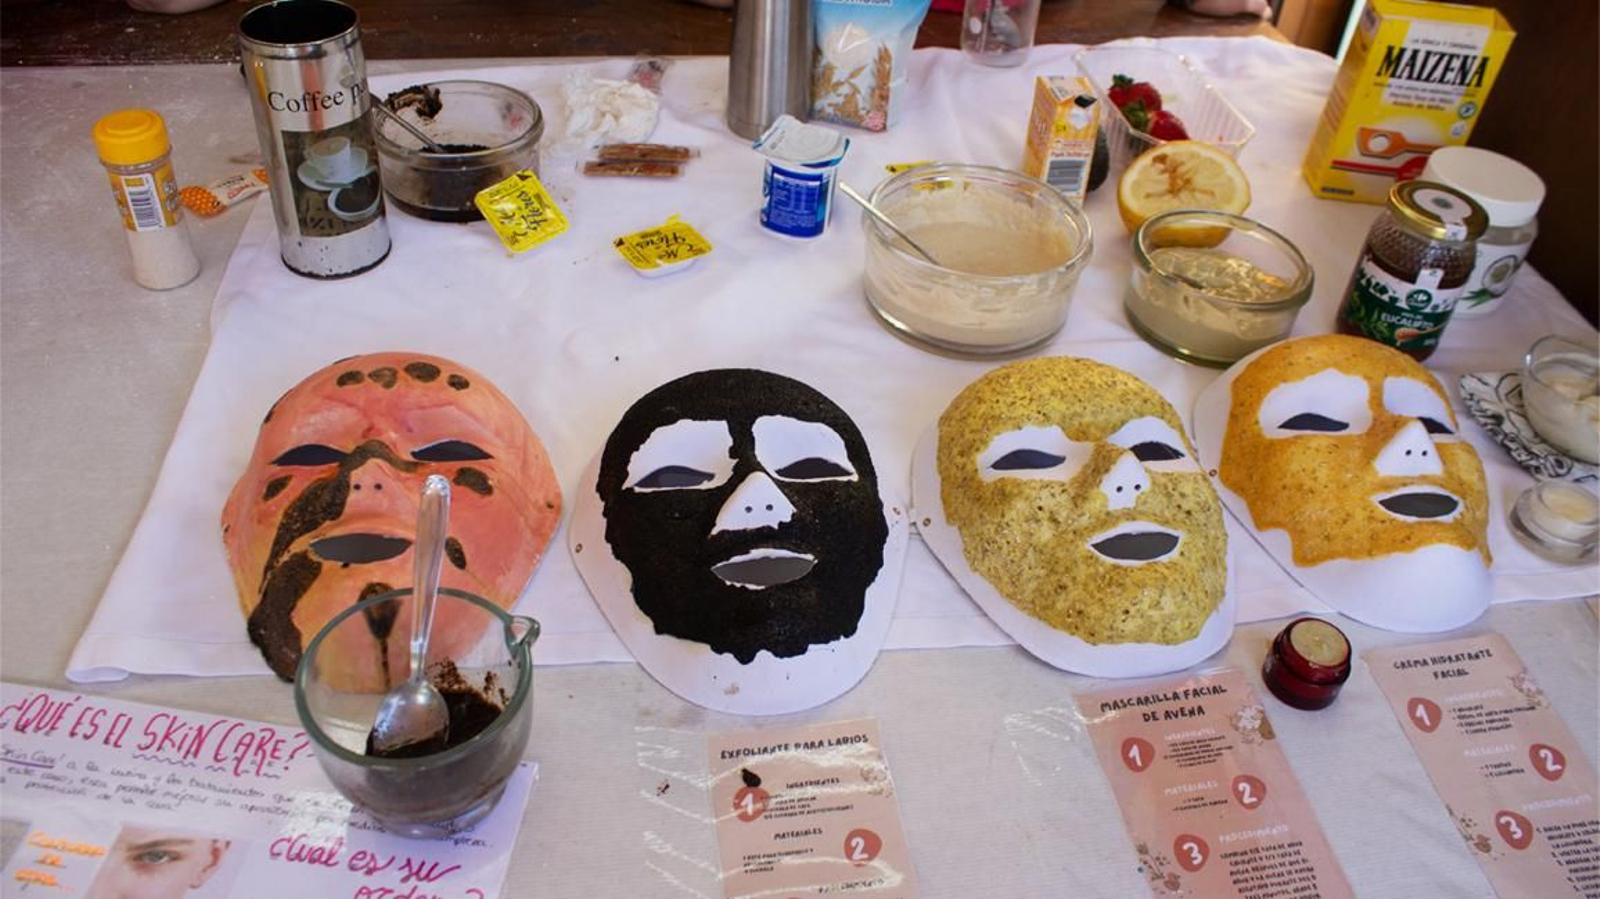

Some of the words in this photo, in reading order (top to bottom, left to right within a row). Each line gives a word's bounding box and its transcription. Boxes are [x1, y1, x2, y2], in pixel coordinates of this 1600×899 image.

[1376, 45, 1490, 89] MAIZENA
[267, 89, 344, 113] Coffee
[1393, 657, 1429, 670] CREMA
[1431, 649, 1493, 665] HIDRATANTE
[1433, 668, 1469, 680] FACIAL
[1100, 692, 1180, 713] MASCARILLA
[1184, 685, 1228, 698] FACIAL
[1142, 712, 1160, 723] DE
[1164, 705, 1205, 721] AVENA
[1415, 704, 1431, 726] 1
[69, 707, 107, 741] ES
[103, 713, 133, 749] EL
[720, 743, 790, 760] EXFOLIANTE
[794, 740, 825, 750] PARA
[828, 734, 869, 747] LABIOS
[1128, 744, 1142, 767] 1
[1539, 749, 1562, 772] 2
[740, 793, 754, 816] 1
[1238, 782, 1257, 804] 2
[773, 828, 823, 841] MATERIALES
[1500, 815, 1523, 840] 3
[851, 837, 869, 860] 2
[1182, 842, 1203, 865] 3
[348, 850, 396, 876] es
[398, 856, 462, 884] su
